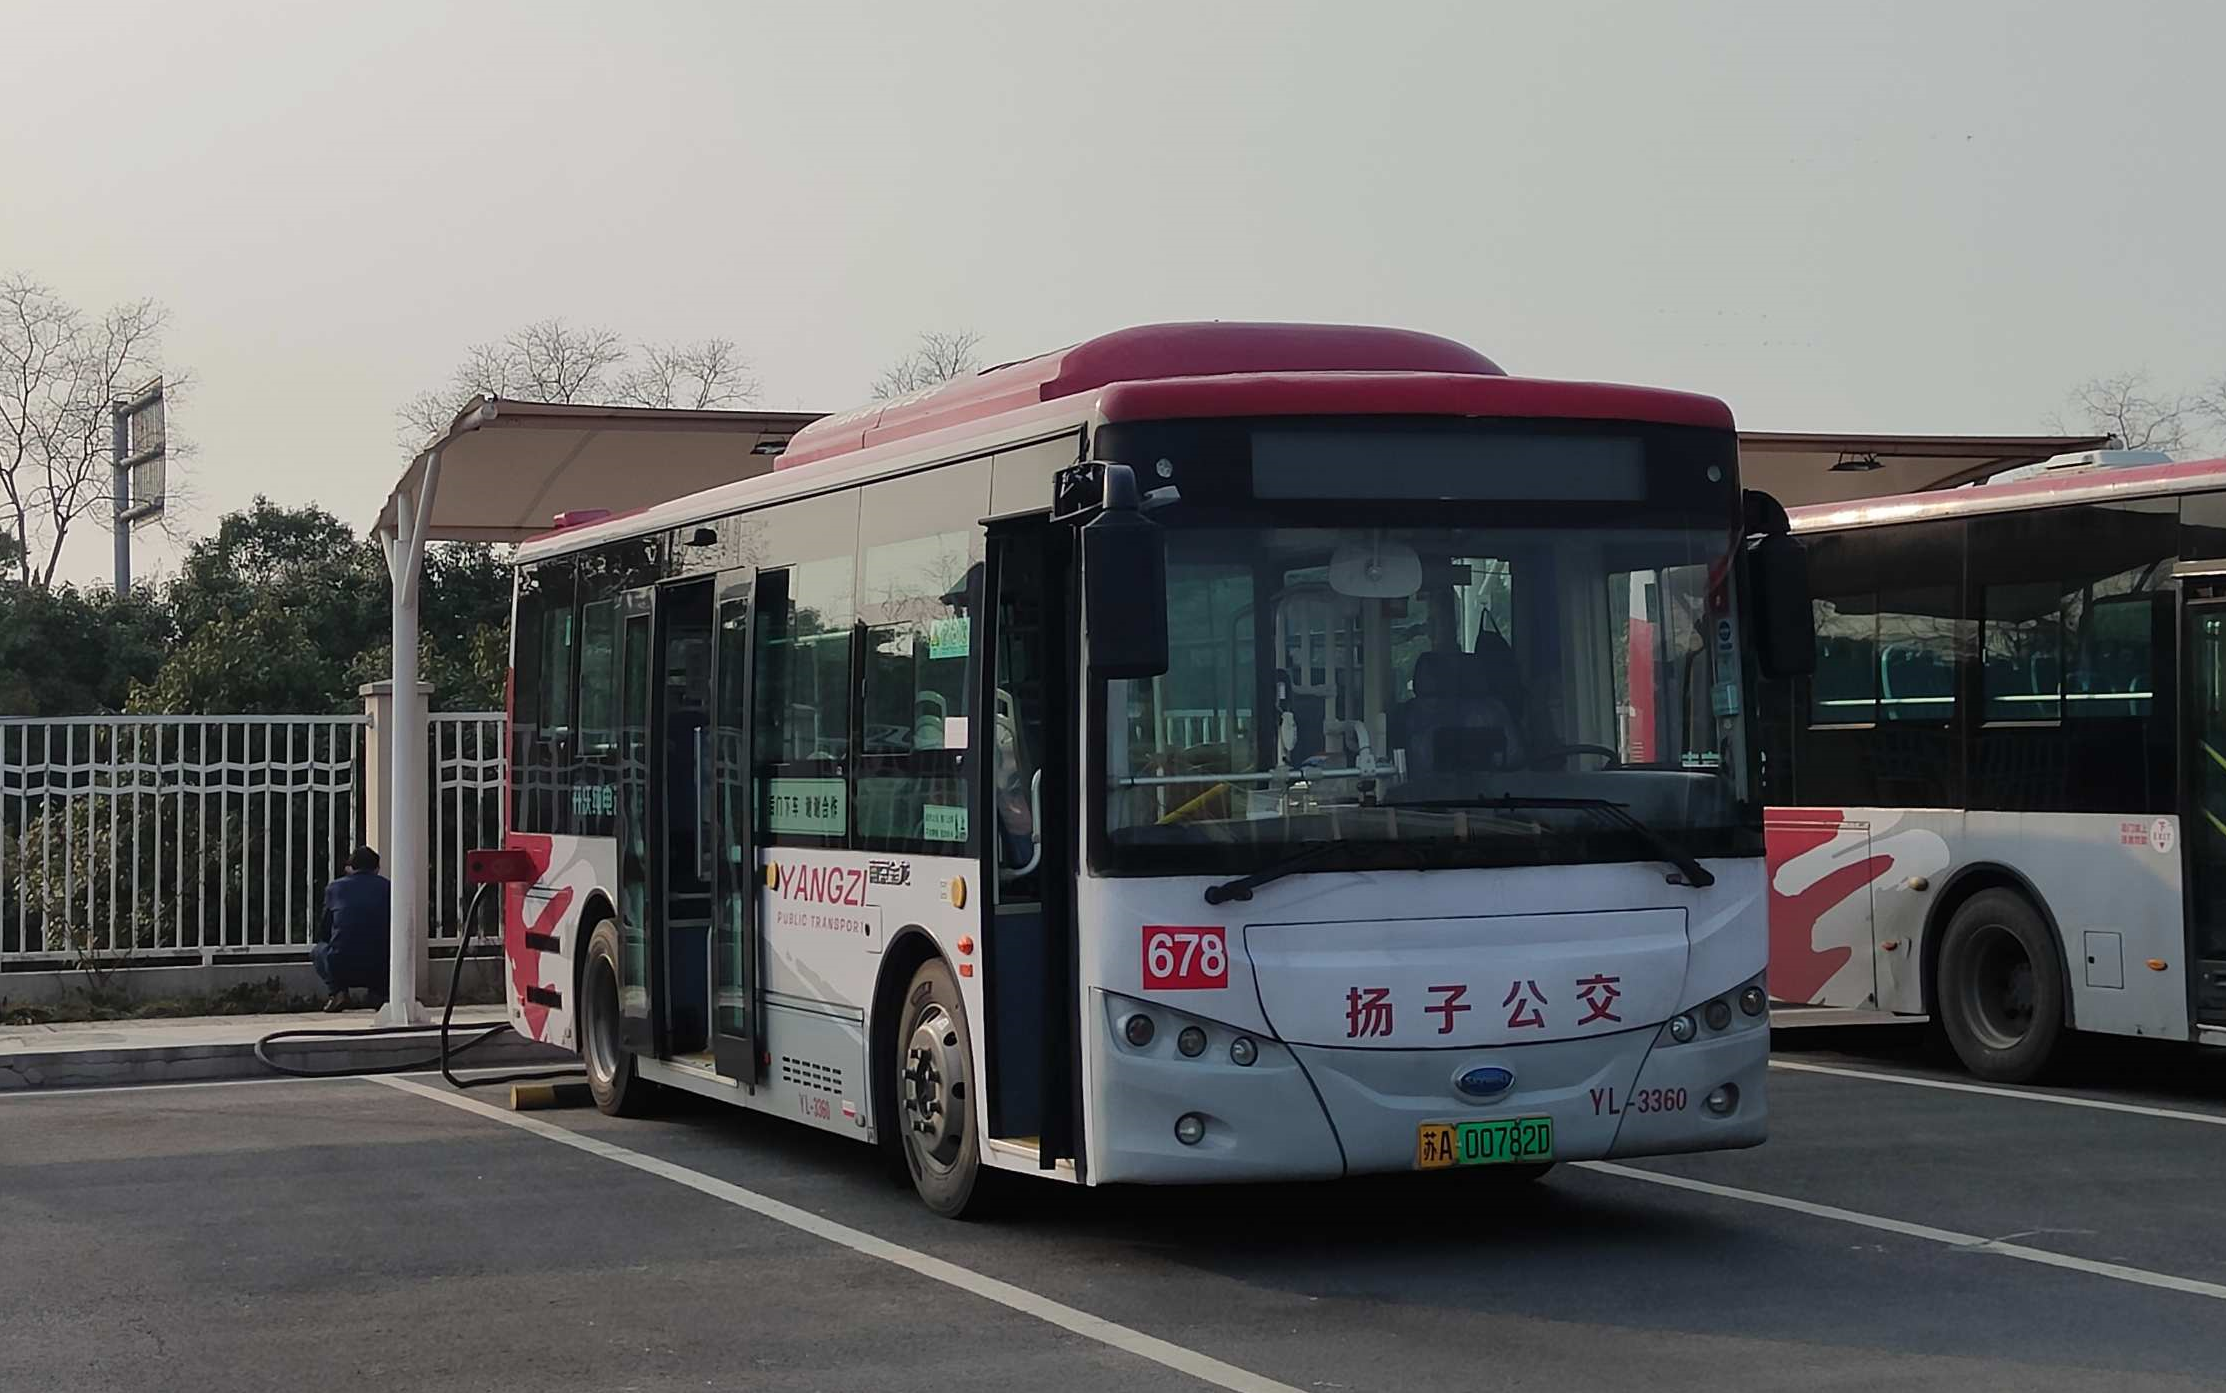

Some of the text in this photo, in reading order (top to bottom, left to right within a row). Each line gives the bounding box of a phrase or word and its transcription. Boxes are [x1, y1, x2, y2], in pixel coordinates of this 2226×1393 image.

[780, 864, 868, 908] YANGZI
[777, 911, 864, 935] PUBLIC TRANSPORT
[1148, 933, 1226, 978] 678
[1345, 973, 1622, 1038] 扬子公交
[1589, 1087, 1687, 1116] YL-3360
